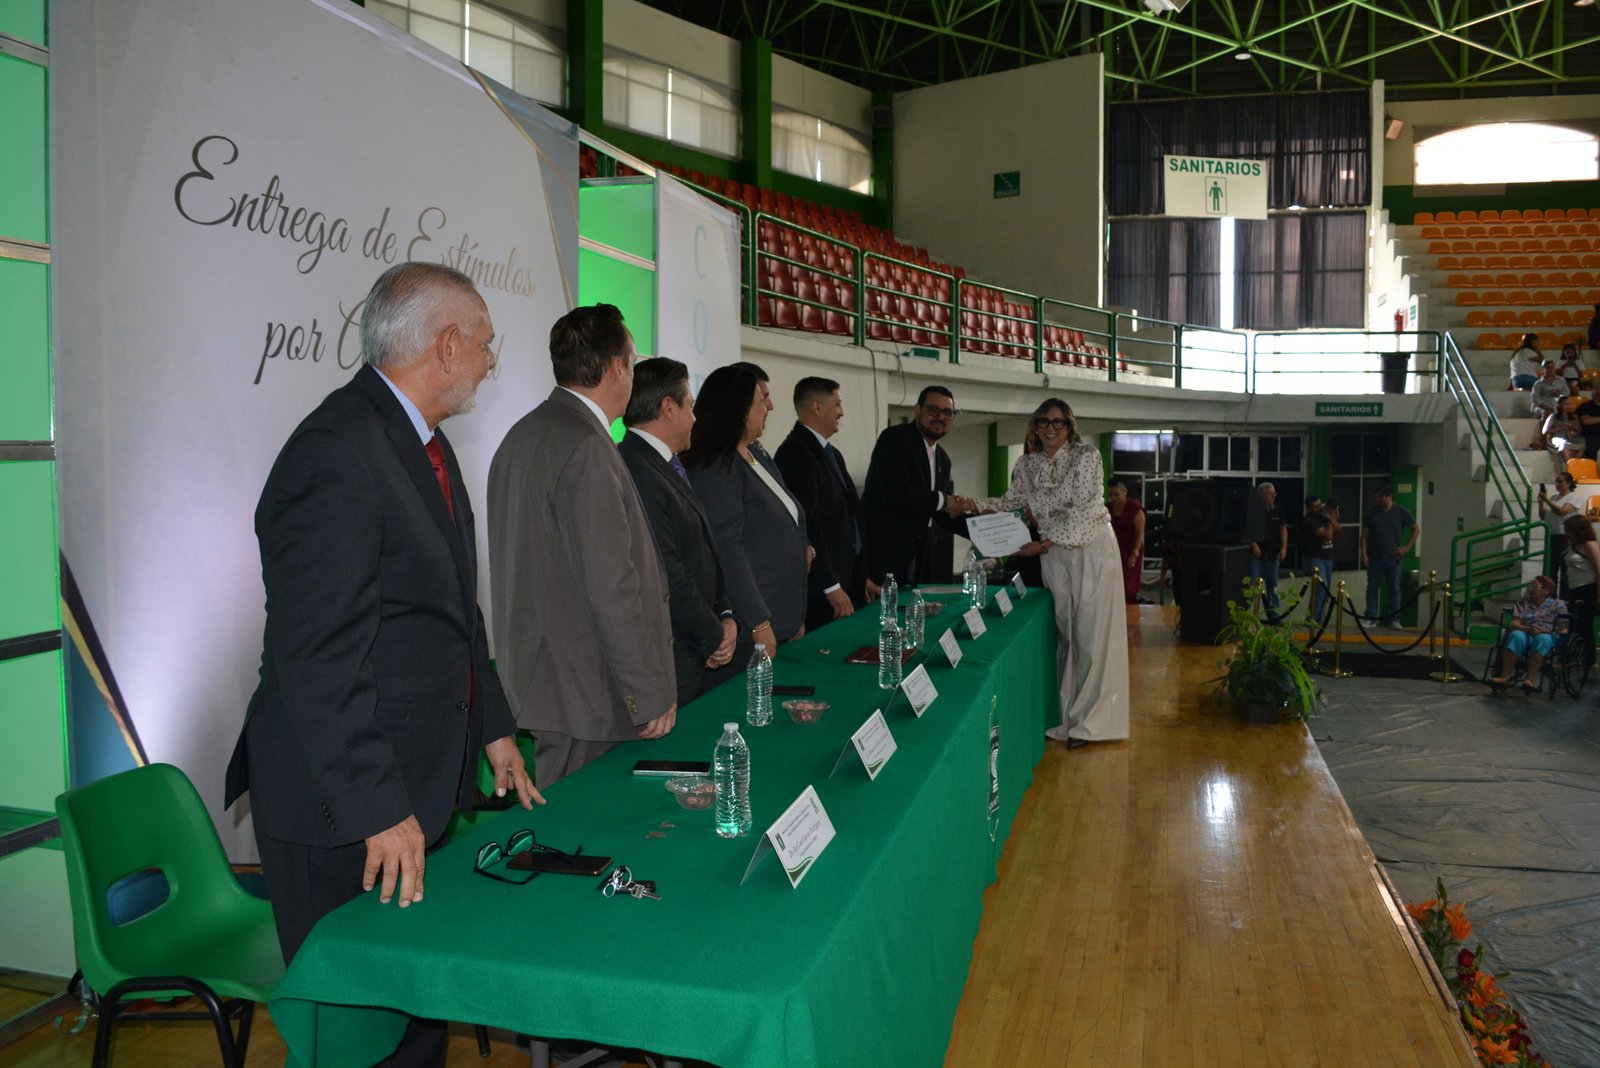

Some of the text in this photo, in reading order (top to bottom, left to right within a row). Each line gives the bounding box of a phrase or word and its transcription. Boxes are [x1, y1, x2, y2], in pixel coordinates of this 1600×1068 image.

[1169, 158, 1261, 176] SANITARIOS
[174, 135, 351, 274] Entrega
[362, 207, 398, 264] de
[253, 317, 326, 385] por
[1319, 405, 1372, 414] SANITARIOS
